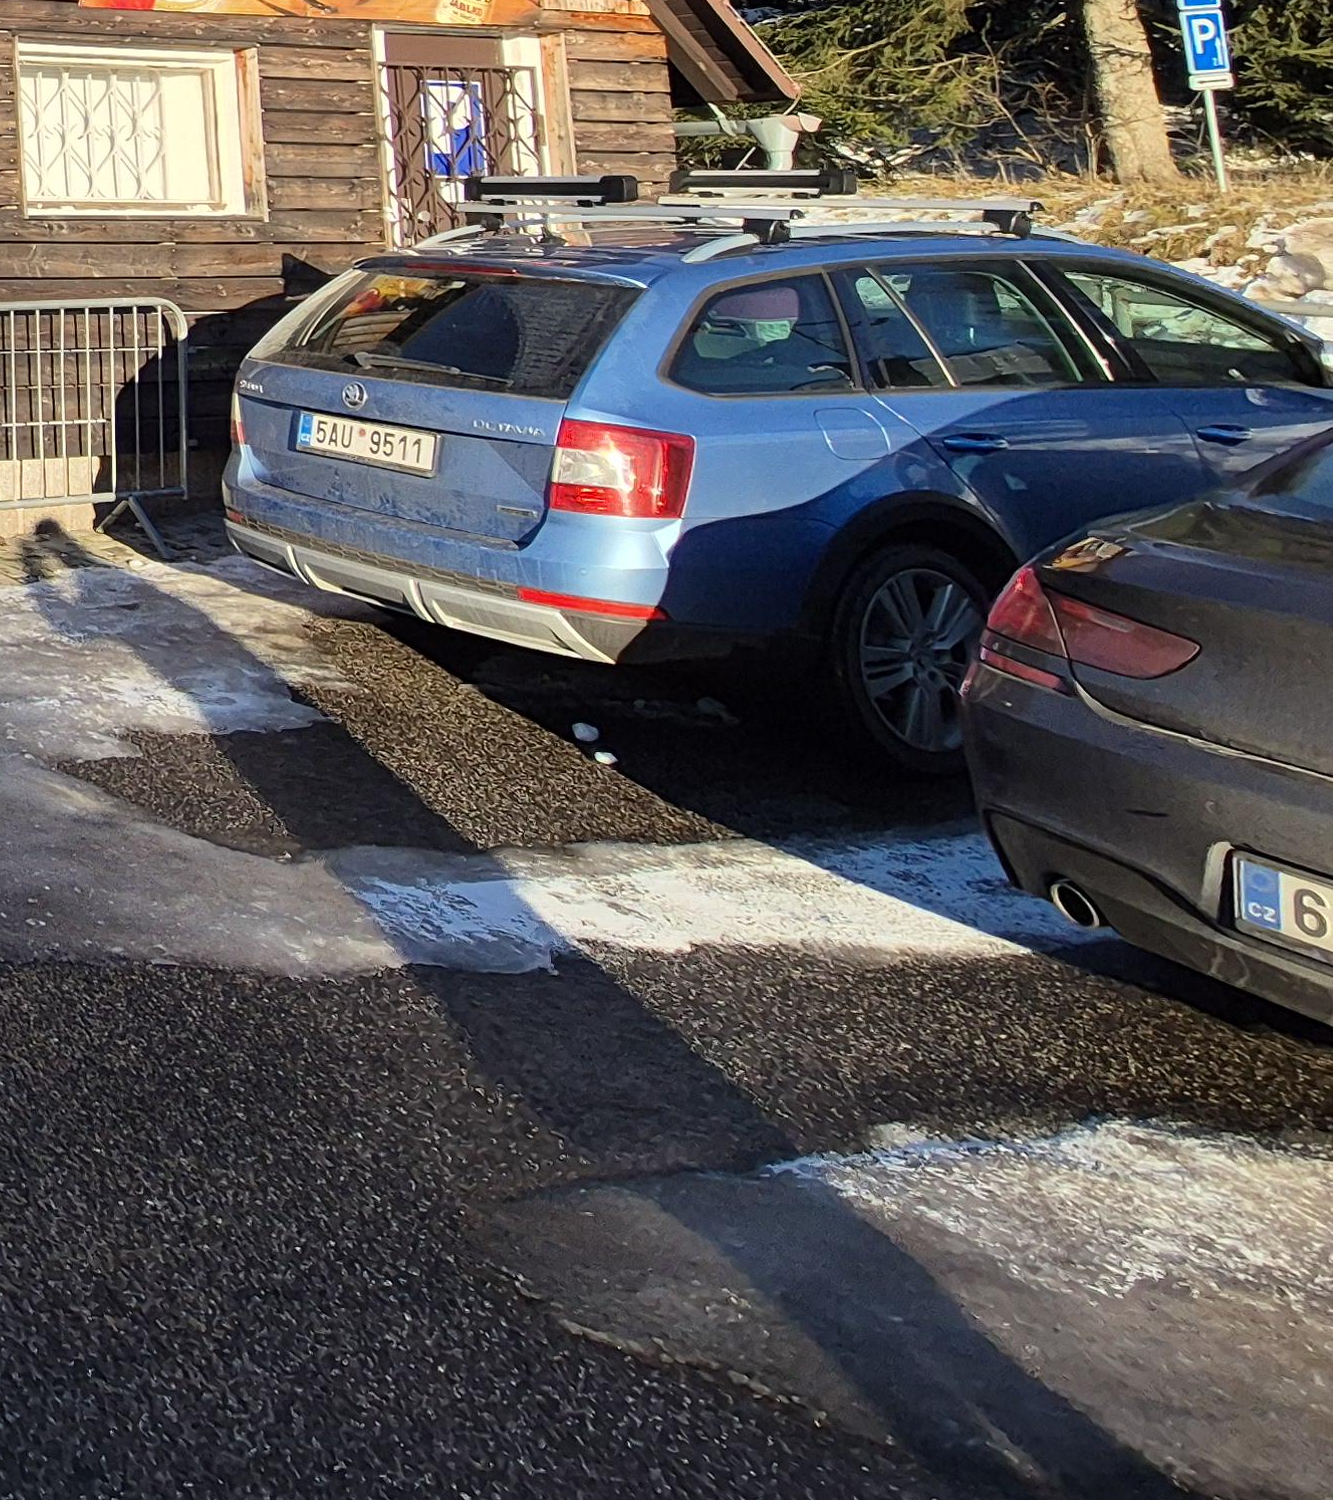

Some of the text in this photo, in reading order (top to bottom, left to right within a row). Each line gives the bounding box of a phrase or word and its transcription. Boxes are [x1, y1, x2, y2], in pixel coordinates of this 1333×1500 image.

[1191, 18, 1218, 55] P
[315, 419, 354, 450] 5AU
[368, 429, 423, 465] 9511
[472, 418, 546, 437] OCTAVIA
[1247, 888, 1329, 940] CZ 6
